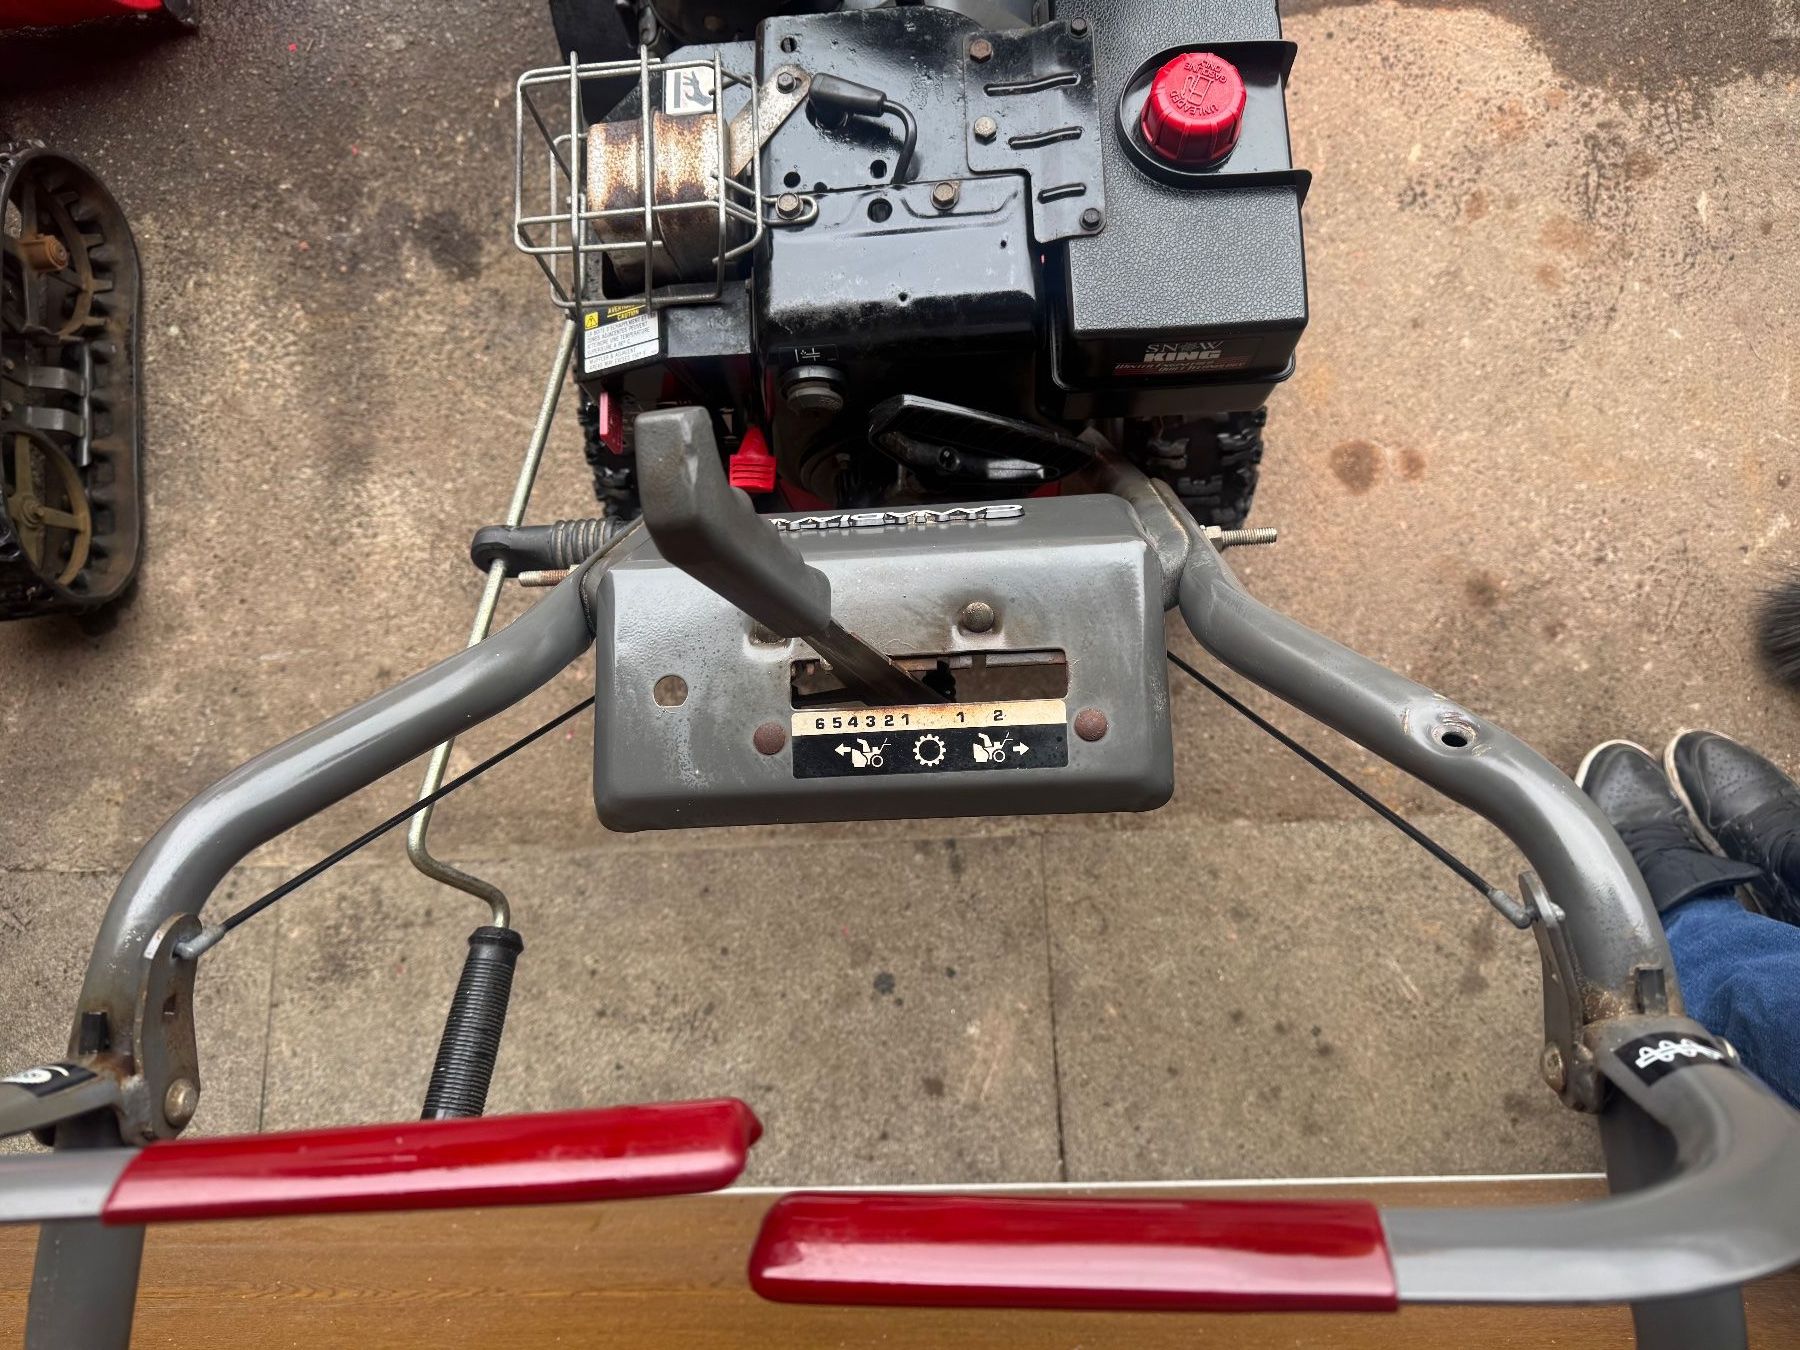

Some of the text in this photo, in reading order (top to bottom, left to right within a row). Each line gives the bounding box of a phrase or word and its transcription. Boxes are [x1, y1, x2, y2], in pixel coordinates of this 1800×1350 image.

[1170, 90, 1219, 116] UNLEADED
[1143, 350, 1222, 362] KING
[815, 709, 1004, 729] 6 5 4 3 2 1 1 2
